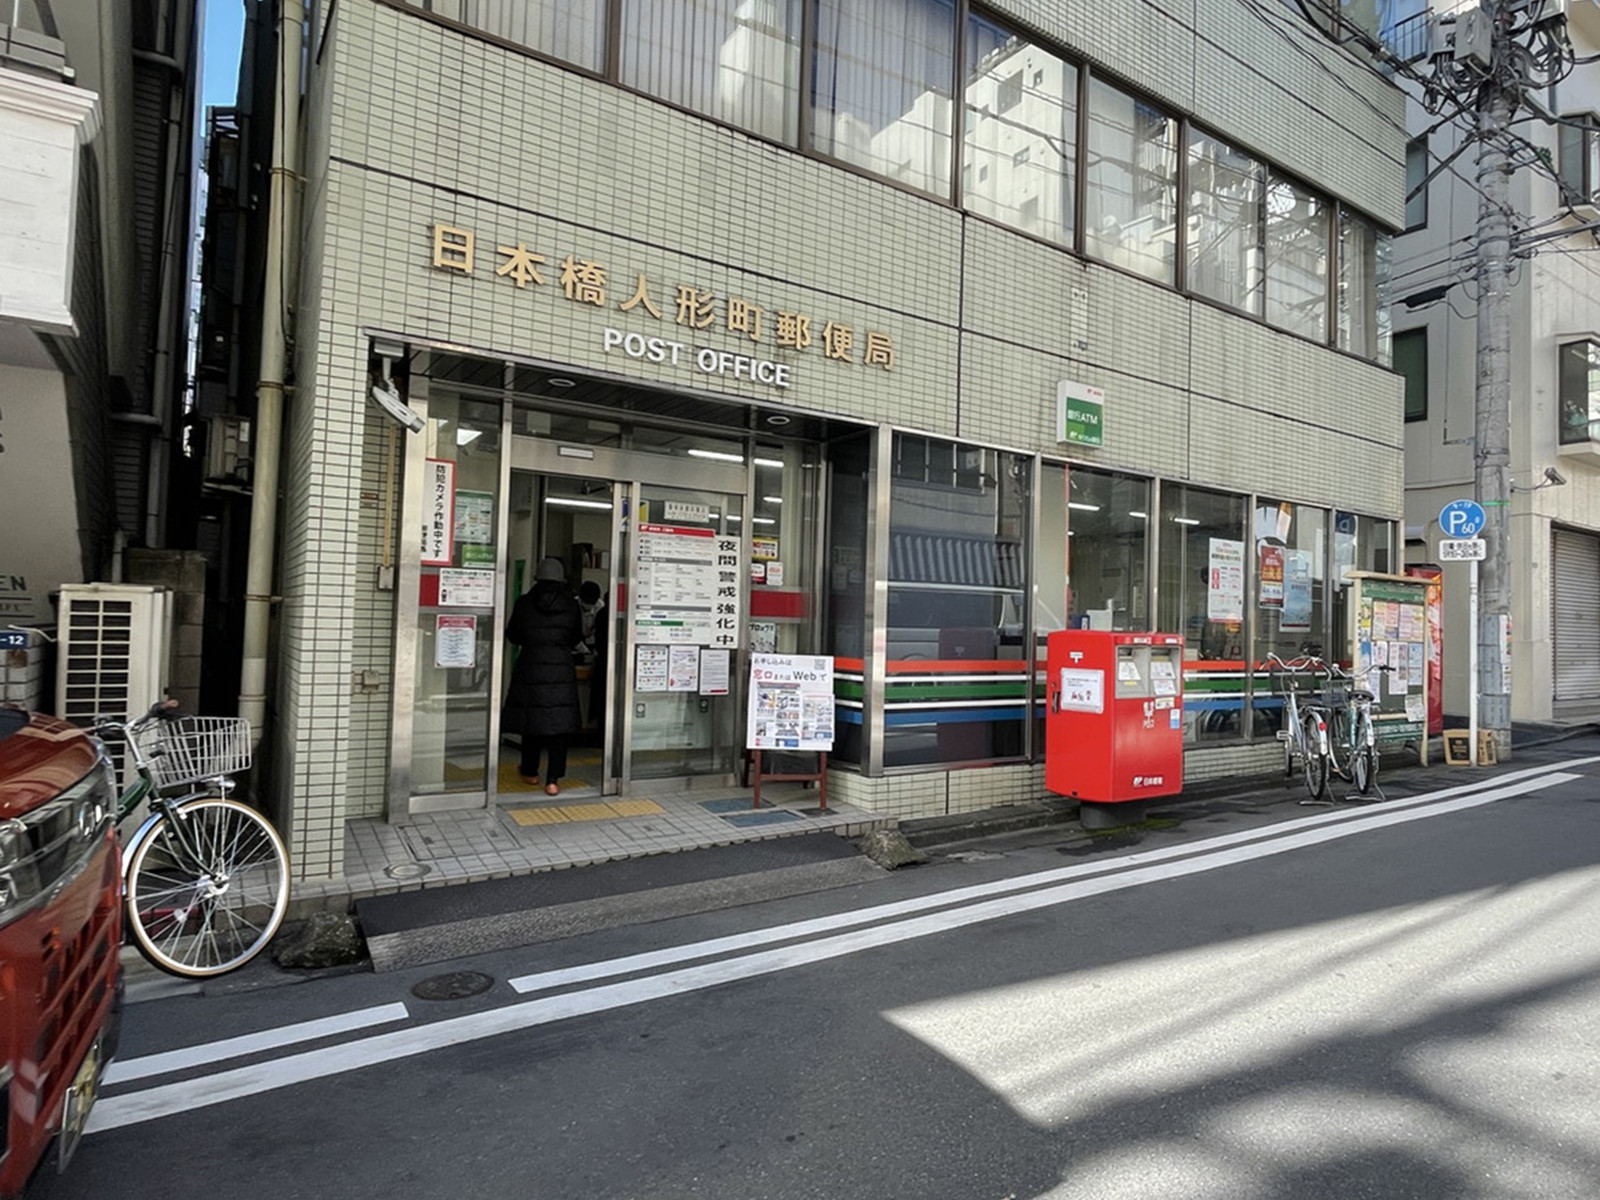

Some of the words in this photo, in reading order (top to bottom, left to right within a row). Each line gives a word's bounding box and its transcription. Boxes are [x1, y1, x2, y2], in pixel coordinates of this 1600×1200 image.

[430, 223, 896, 372] 日本橋人形町郵便局
[603, 327, 684, 367] POST
[696, 347, 791, 389] OFFICE
[433, 464, 446, 558] 防犯カメラ作動中です
[1450, 511, 1467, 534] P
[1461, 522, 1475, 534] 60
[716, 539, 737, 645] 夜間警戒強化中
[753, 657, 792, 666] お申し込みは
